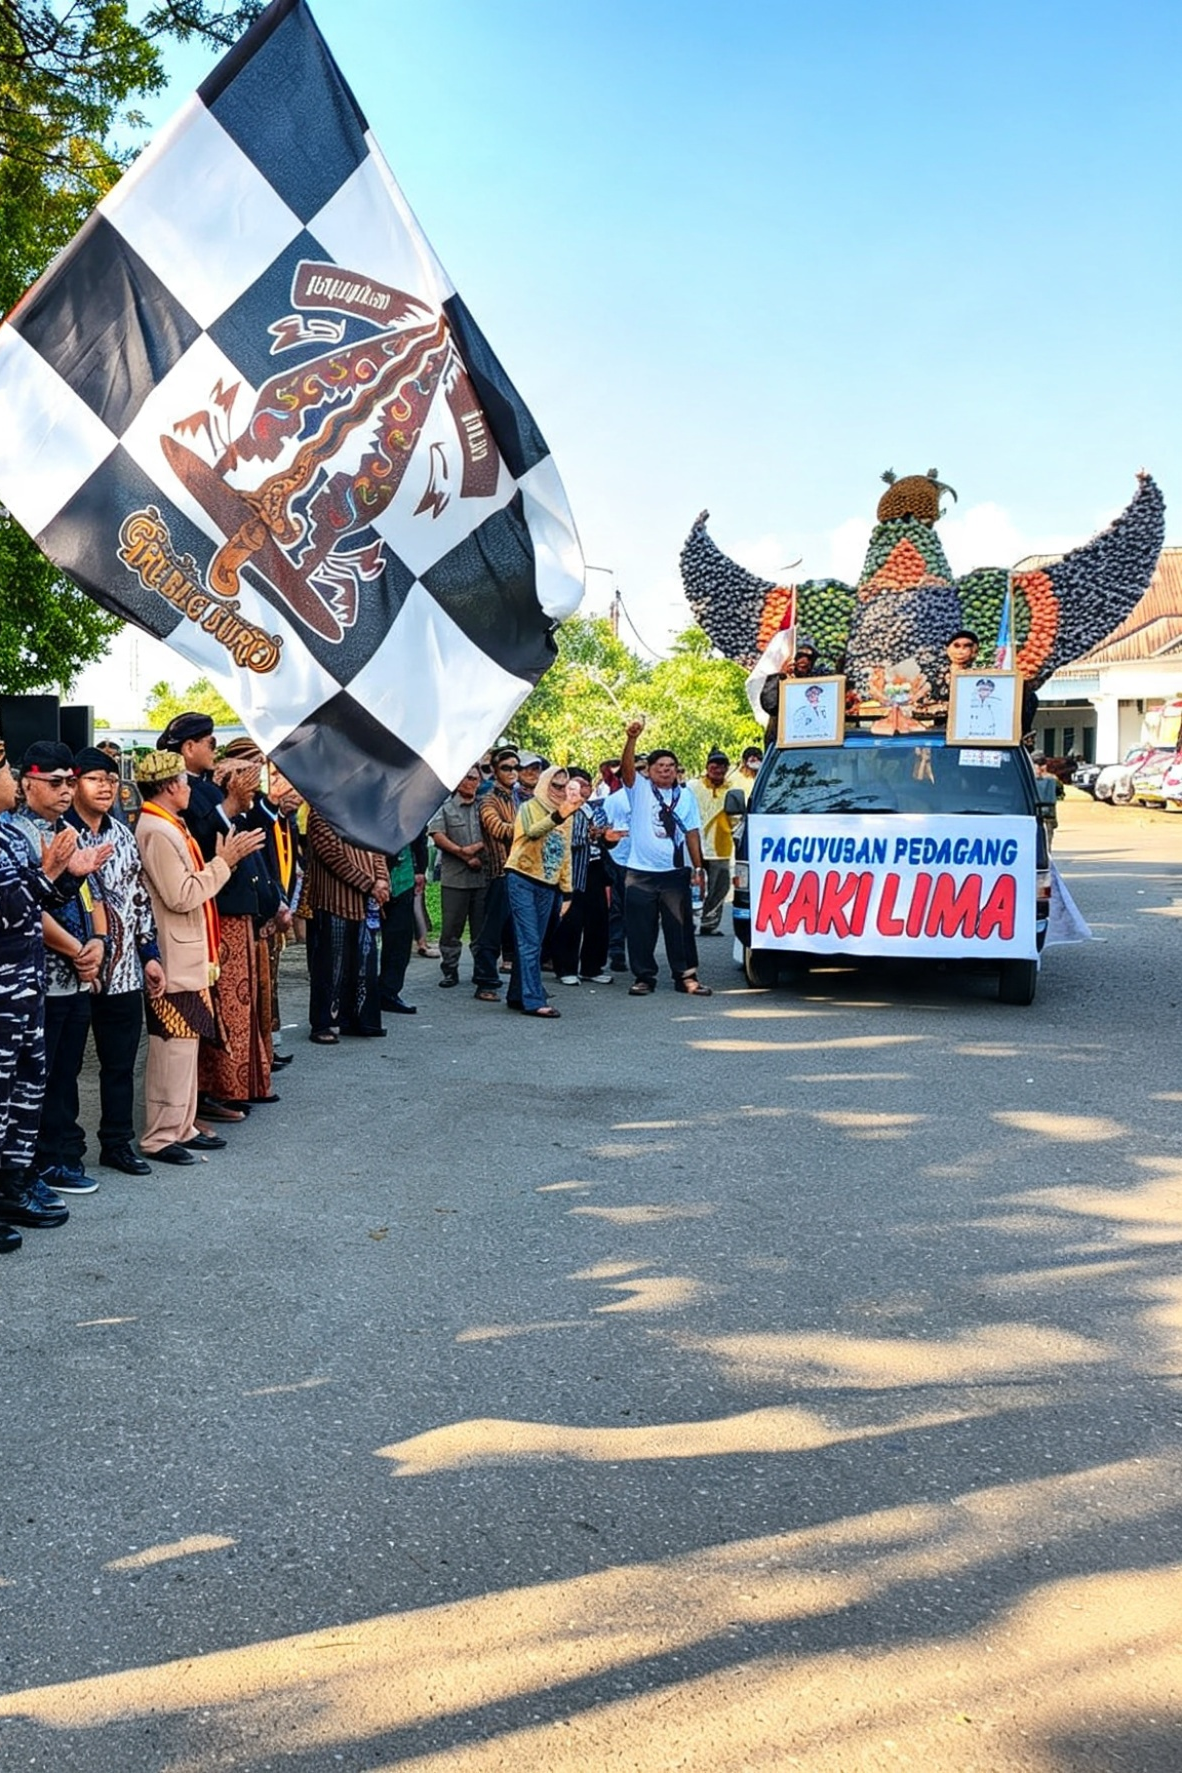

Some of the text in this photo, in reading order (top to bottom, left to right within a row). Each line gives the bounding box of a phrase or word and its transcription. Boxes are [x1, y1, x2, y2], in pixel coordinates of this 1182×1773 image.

[760, 836, 1018, 866] PAGUYUBAN PEDAGANG
[756, 869, 1016, 940] KAKI LIMA
